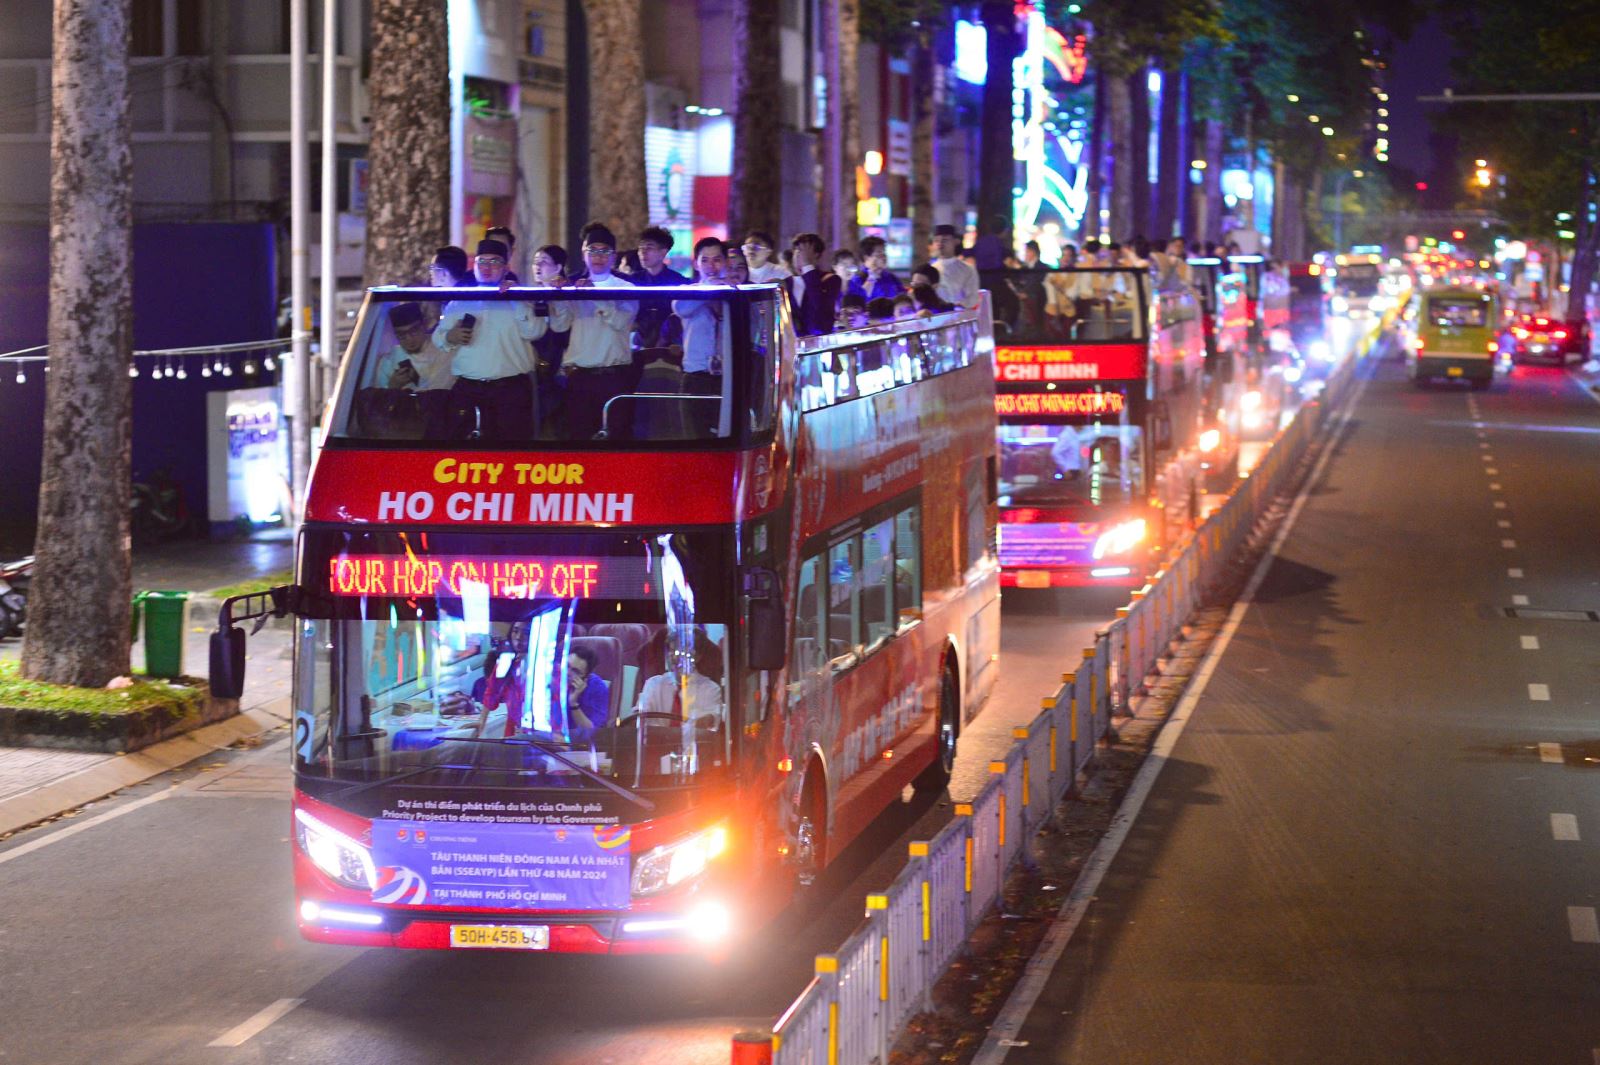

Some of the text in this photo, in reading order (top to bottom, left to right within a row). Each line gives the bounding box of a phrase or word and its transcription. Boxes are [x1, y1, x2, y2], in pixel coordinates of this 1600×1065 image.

[1004, 363, 1041, 379] CHI
[1043, 363, 1098, 379] MINH
[433, 458, 585, 485] CITY TOUR
[377, 491, 634, 522] HO CHI MINH
[393, 560, 443, 594] HOP
[449, 561, 487, 596] ON
[493, 562, 544, 597] HOP
[550, 564, 598, 598] OFF
[412, 800, 423, 809] án
[462, 801, 483, 811] phát
[506, 803, 519, 811] du
[382, 809, 619, 824] Priority Project to develop tourism by the Government
[453, 852, 488, 862] THANH
[489, 853, 512, 863] NIÊN
[514, 854, 545, 864] ĐÔNG
[546, 856, 570, 865] NAM
[596, 856, 624, 867] NHẬT
[453, 866, 497, 878] (SSEAYP)
[542, 869, 555, 878] 48
[557, 869, 581, 879] NĂM
[582, 871, 607, 880] 2024
[450, 888, 482, 899] THÀNH
[541, 892, 567, 901] MINH
